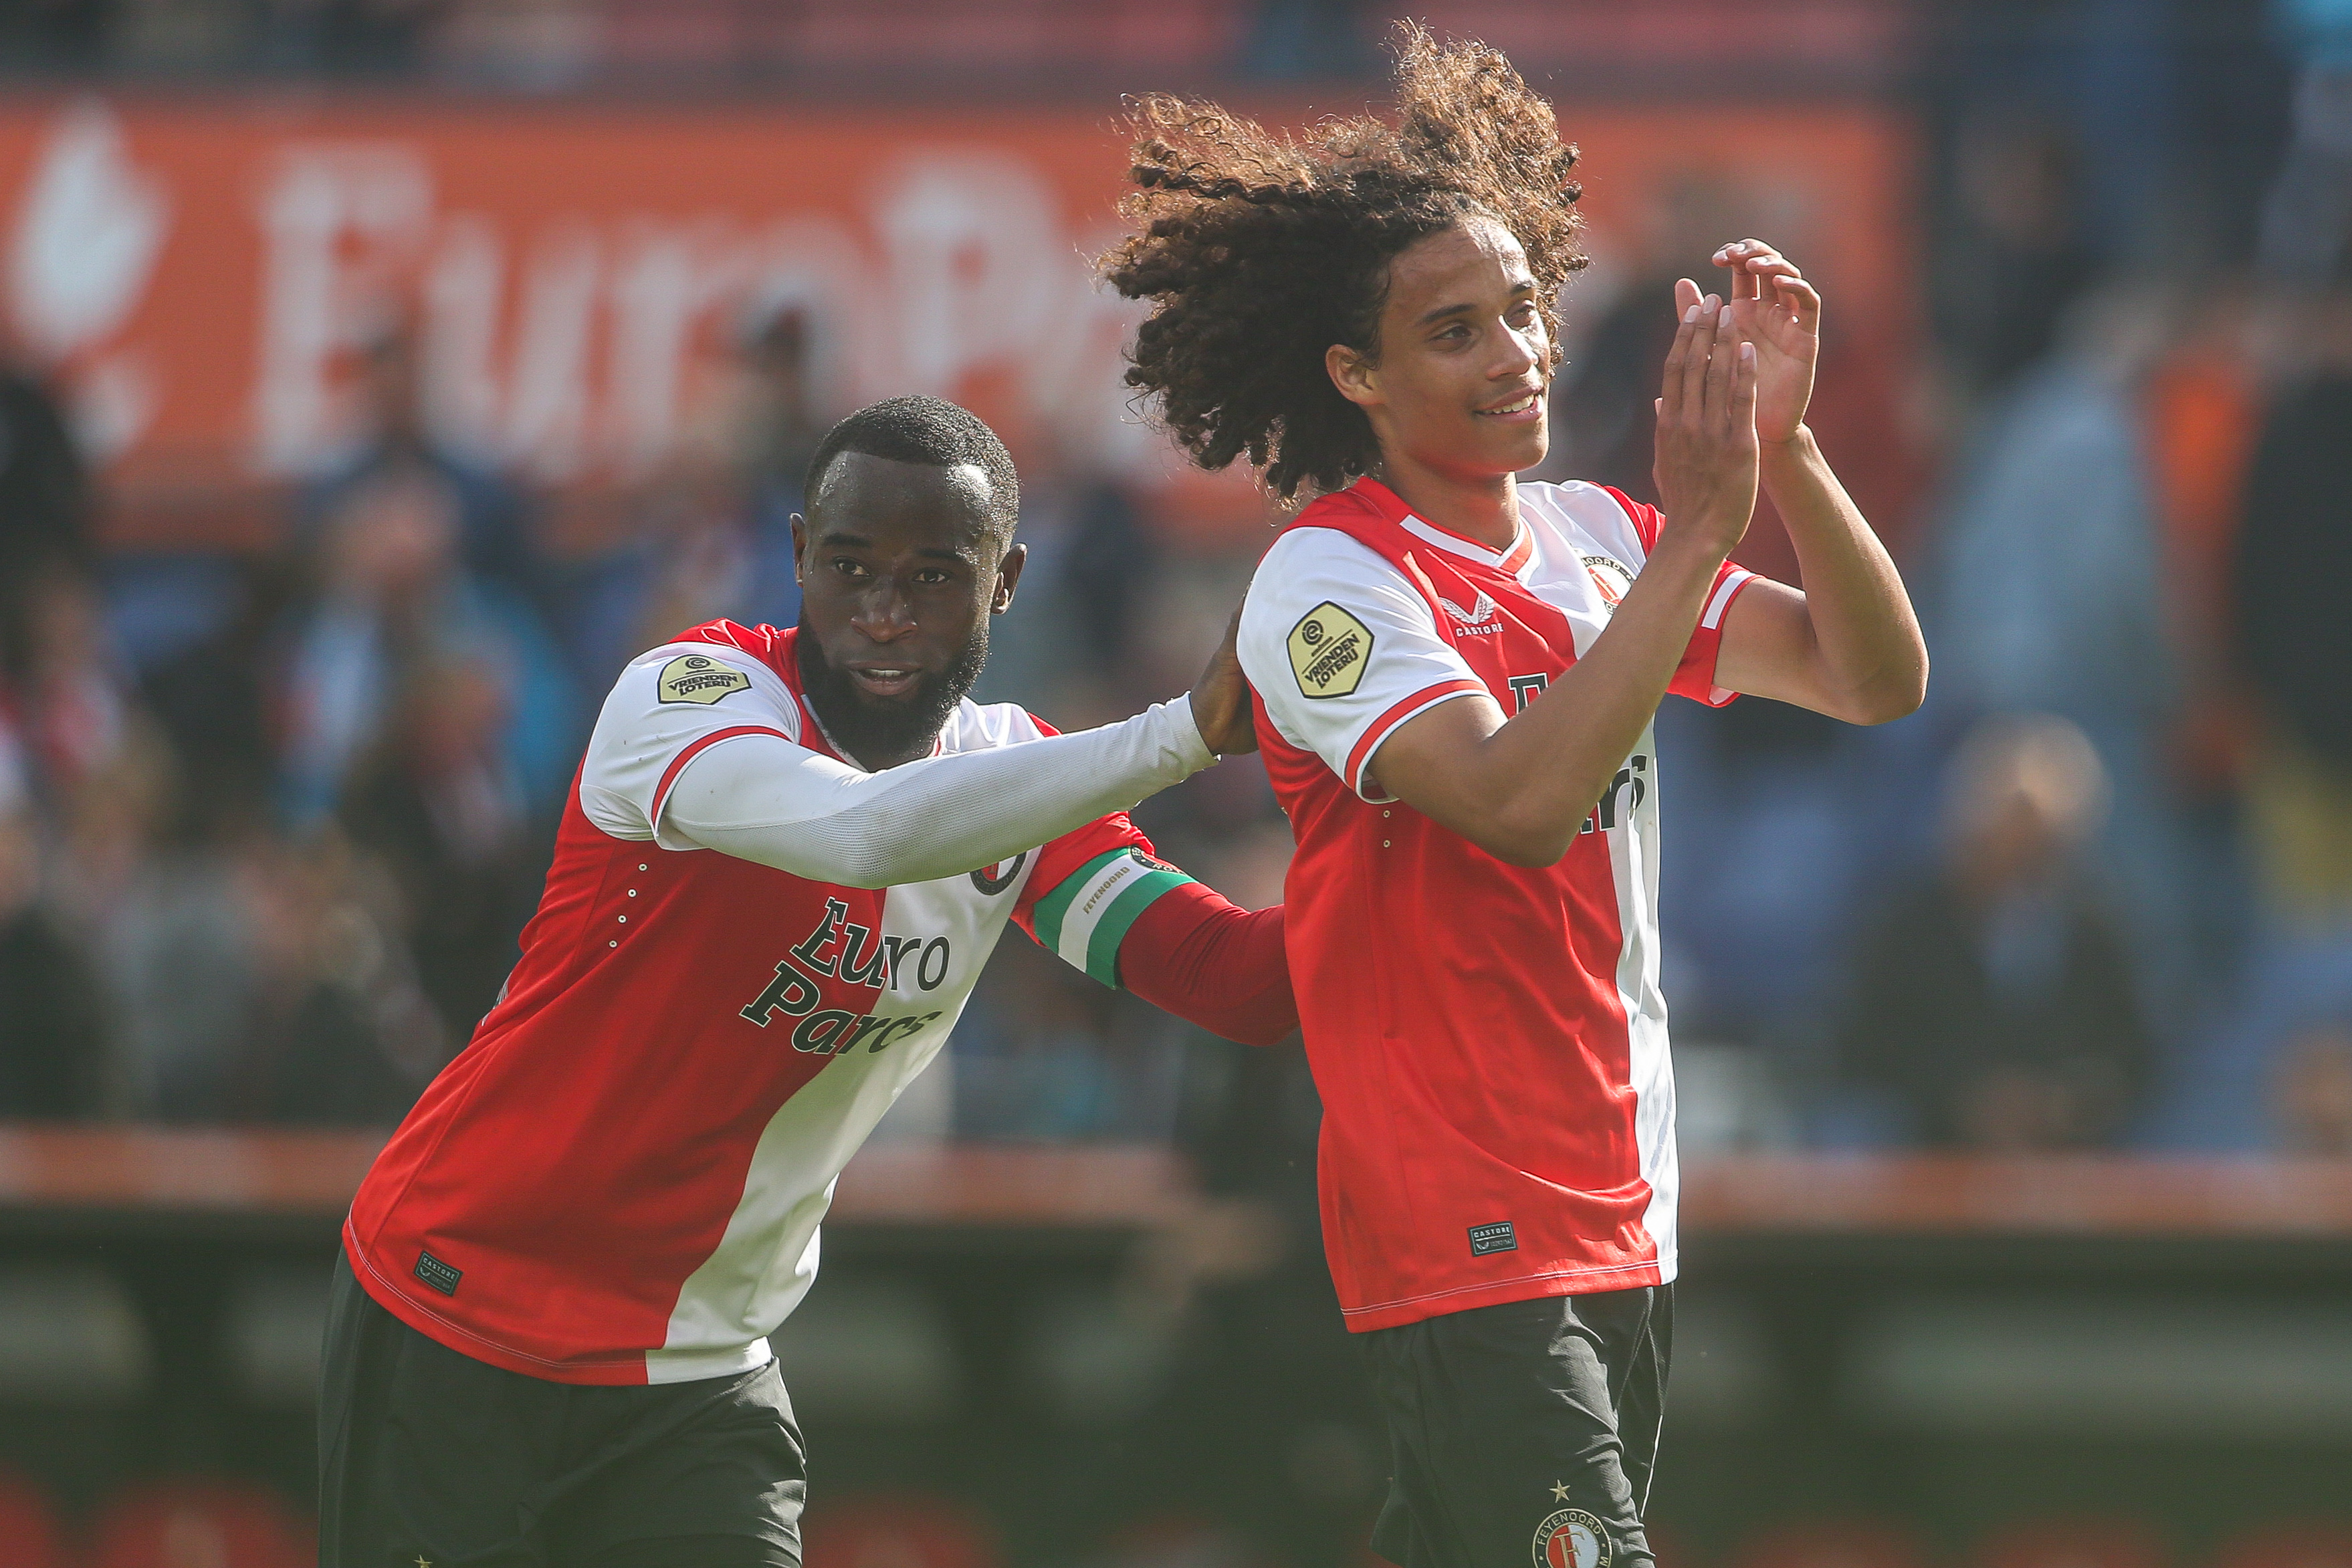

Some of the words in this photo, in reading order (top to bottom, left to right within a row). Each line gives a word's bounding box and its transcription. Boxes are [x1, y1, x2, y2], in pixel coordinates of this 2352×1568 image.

[1455, 622, 1504, 637] CASTORE
[1304, 633, 1361, 683] VRIENDEN
[1315, 648, 1359, 690] LOTERIJ
[668, 674, 739, 691] VRIENDEN
[678, 680, 731, 697] LOTERIJ
[1083, 867, 1131, 914] FEYENOORD
[788, 896, 951, 992] Euro
[738, 960, 944, 1056] Parcs
[1473, 1226, 1511, 1238] CASTORE
[423, 1257, 455, 1280] CASTORE
[1536, 1512, 1602, 1546] FEYENOORD
